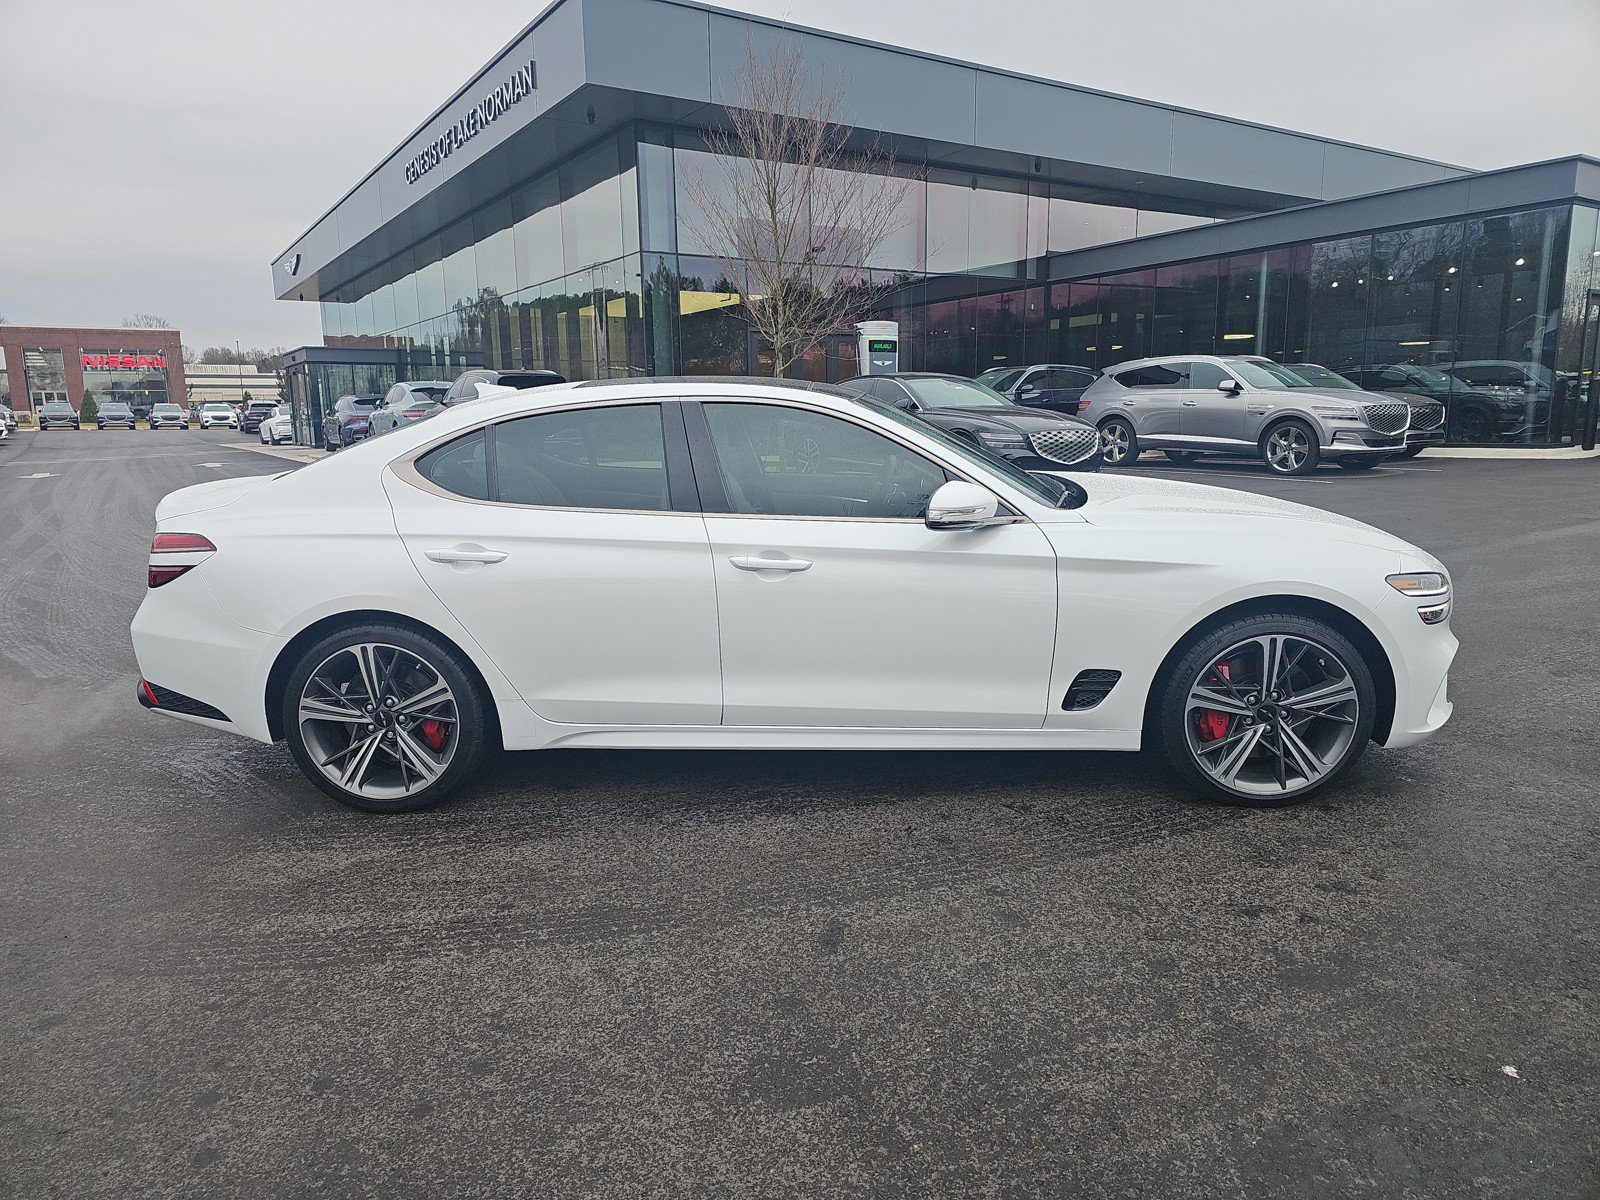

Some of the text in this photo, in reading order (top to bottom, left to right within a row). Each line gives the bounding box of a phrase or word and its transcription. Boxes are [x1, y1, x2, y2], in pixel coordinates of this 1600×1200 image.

[404, 60, 537, 184] GENESIS OF LAKE NORMAN
[82, 354, 166, 367] NISSAN
